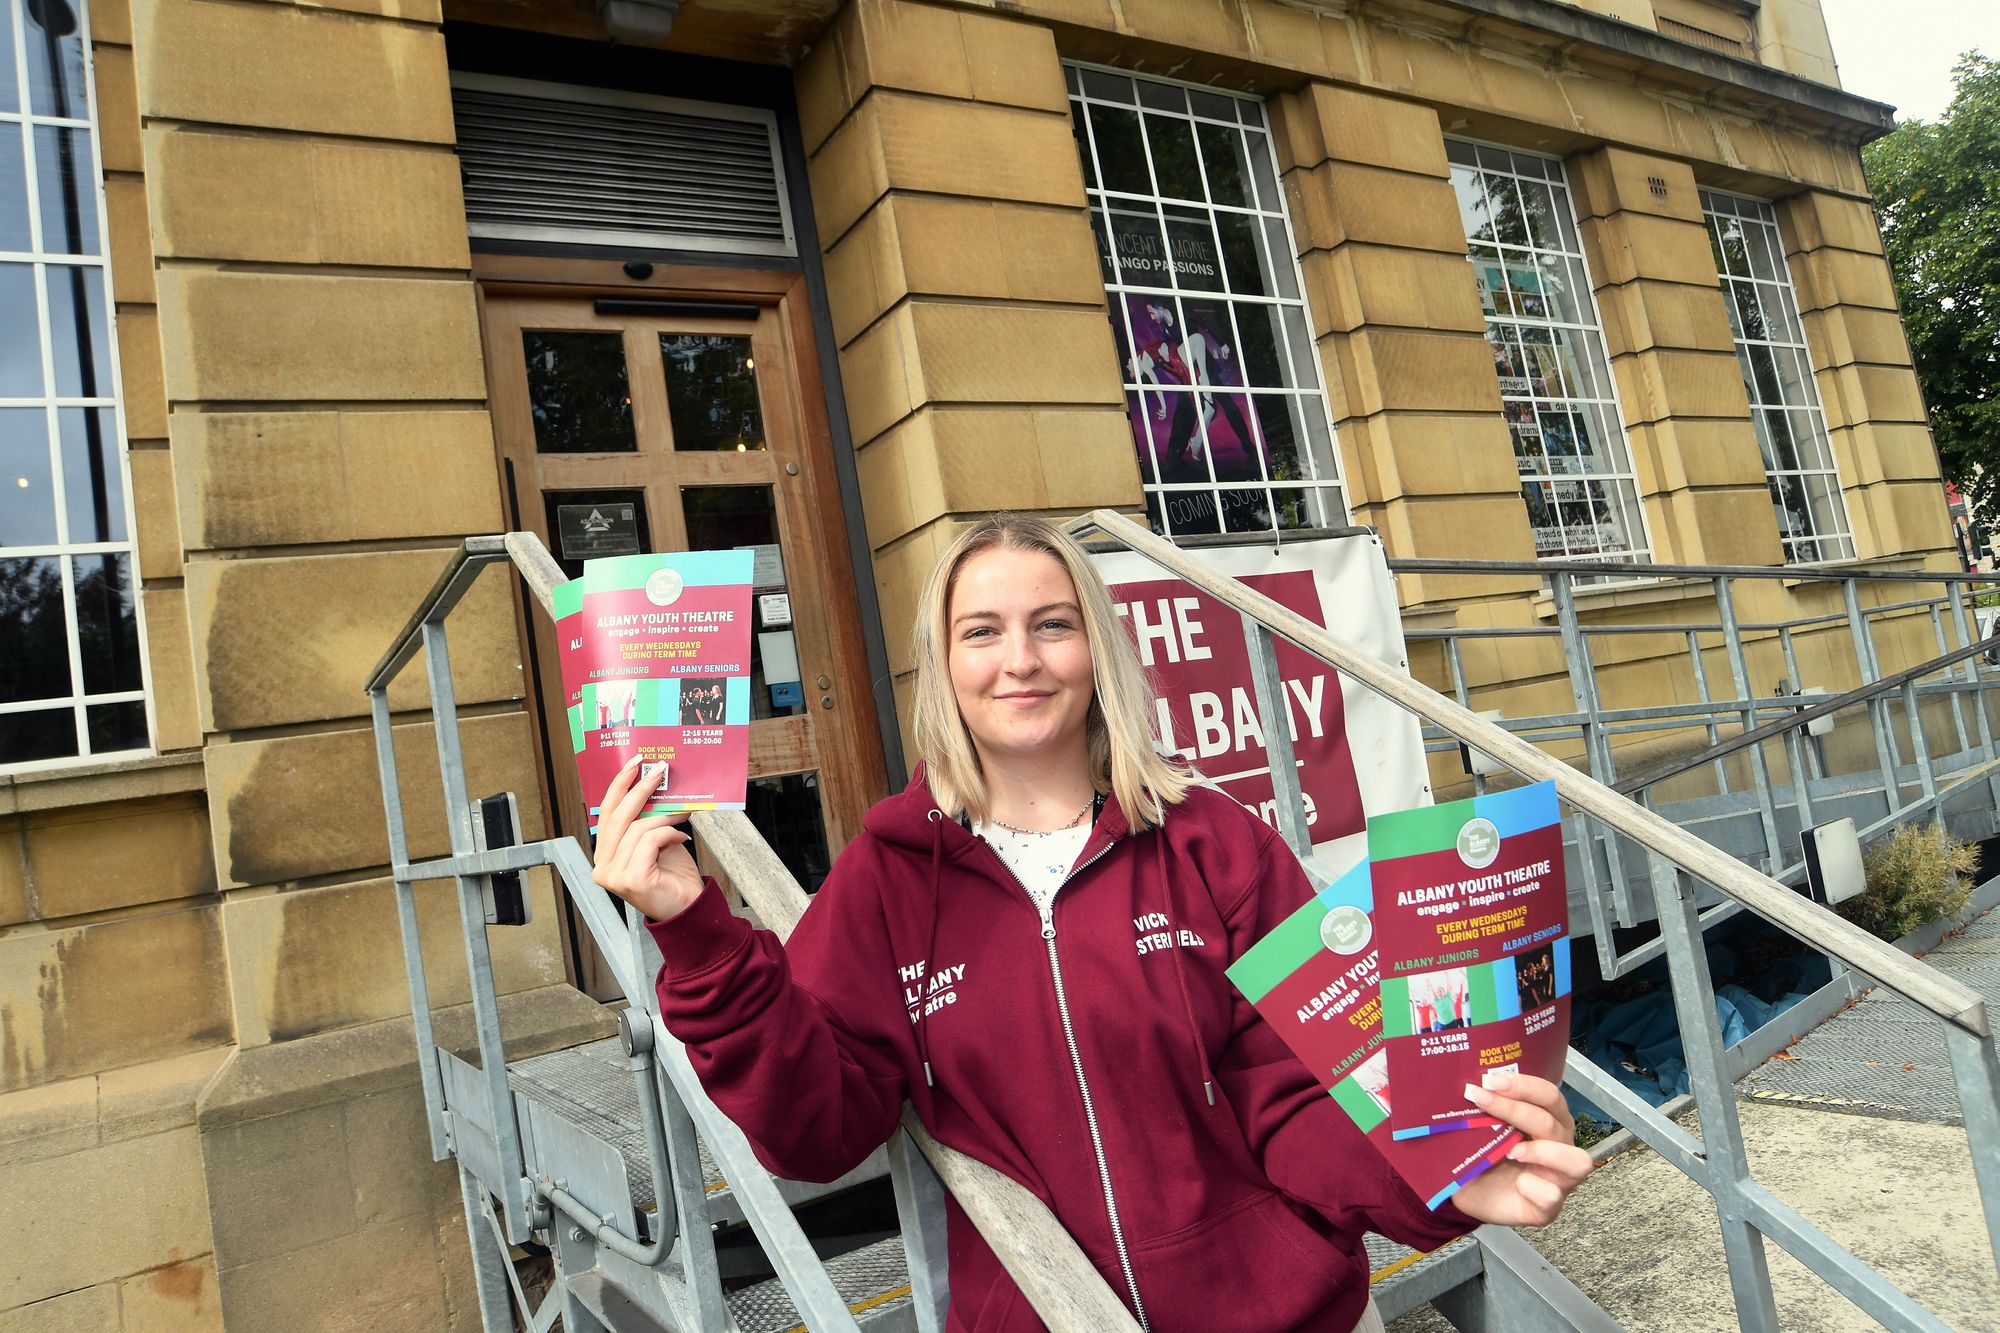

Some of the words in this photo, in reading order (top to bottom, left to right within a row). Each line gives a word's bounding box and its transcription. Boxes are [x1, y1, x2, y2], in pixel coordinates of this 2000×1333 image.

[1098, 231, 1156, 256] VNCENT
[1160, 238, 1211, 261] SMONE
[1153, 259, 1214, 276] PASSIONS
[1555, 402, 1578, 411] dace
[1520, 426, 1539, 435] dram
[1537, 527, 1556, 539] Proud
[596, 613, 638, 628] ALBANY
[641, 612, 680, 624] YOUTH
[682, 610, 734, 622] THEATRE
[608, 628, 640, 638] engage
[648, 625, 680, 635] inspire
[688, 624, 719, 633] create
[1113, 597, 1213, 667] HE
[620, 642, 645, 651] EVERY
[646, 641, 701, 650] WEDNESDAYS
[622, 650, 652, 660] DURING
[654, 650, 676, 658] TERM
[677, 649, 697, 658] TIME
[589, 668, 615, 678] ALBANY
[616, 666, 649, 675] JUNIORS
[670, 665, 703, 674] ALBANY
[704, 663, 740, 672] SENIORS
[1154, 675, 1325, 760] LBAY
[612, 731, 630, 739] YEARS
[683, 737, 722, 745] 18:30-20:00
[1397, 884, 1455, 906] ALBANY
[1458, 874, 1502, 895] YOUTH
[1504, 860, 1551, 885] THEATRE
[1416, 900, 1459, 917] engage
[1469, 891, 1505, 907] inspire
[1512, 881, 1540, 897] create
[1436, 920, 1468, 934] EVERY
[1469, 905, 1528, 930] WEDNESDAYS
[1441, 930, 1479, 945] DURING
[1480, 924, 1505, 937] TERM
[1507, 917, 1526, 930] TIME
[1502, 935, 1532, 952] ALBANY
[1533, 924, 1562, 942] SENIORS
[1393, 957, 1434, 971] ALBANY
[1437, 949, 1479, 965] JUNIORS
[898, 960, 925, 982] HE
[905, 963, 966, 1005] LANY
[909, 991, 957, 1024] atre
[1296, 976, 1348, 1024] ALBANY
[1321, 989, 1361, 1021] engage
[1348, 998, 1379, 1026] EVERY
[1420, 1042, 1470, 1056] 17:00-18:15
[1421, 1036, 1440, 1046] 8-11
[1441, 1032, 1468, 1043] YEARS
[1480, 1047, 1503, 1057] BOOK
[1503, 1041, 1521, 1052] YOUR
[1331, 1045, 1367, 1077] ALBANY
[1479, 1055, 1504, 1066] PLACE
[1505, 1050, 1522, 1061] NOW!
